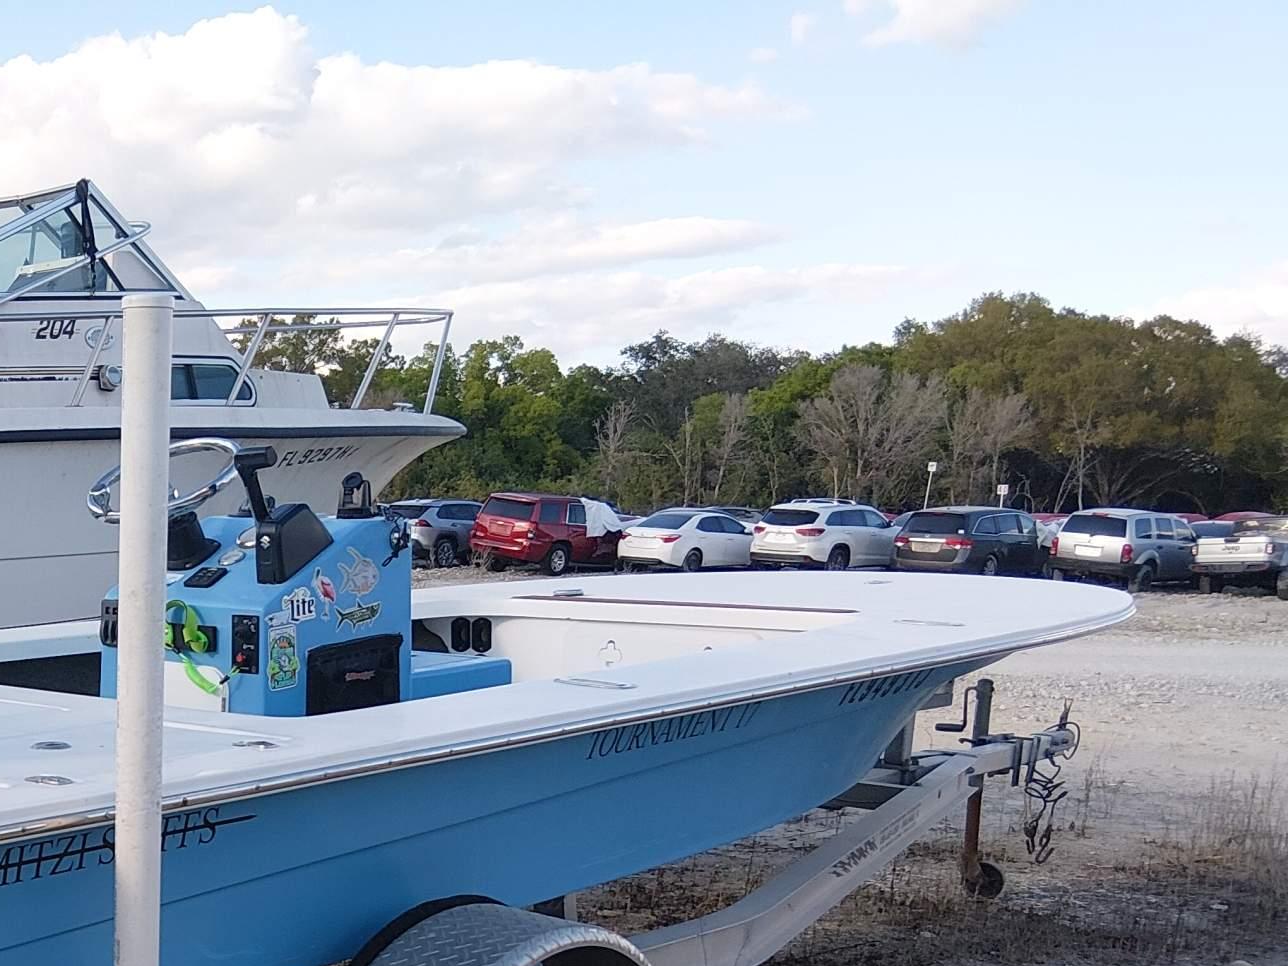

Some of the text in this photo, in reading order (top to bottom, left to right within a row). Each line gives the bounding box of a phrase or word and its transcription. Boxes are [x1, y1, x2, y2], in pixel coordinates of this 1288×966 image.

[35, 319, 76, 340] 204
[277, 450, 298, 468] FL
[289, 598, 316, 622] Lite
[585, 706, 736, 760] TOURNAMENT
[98, 807, 220, 865] SFFS
